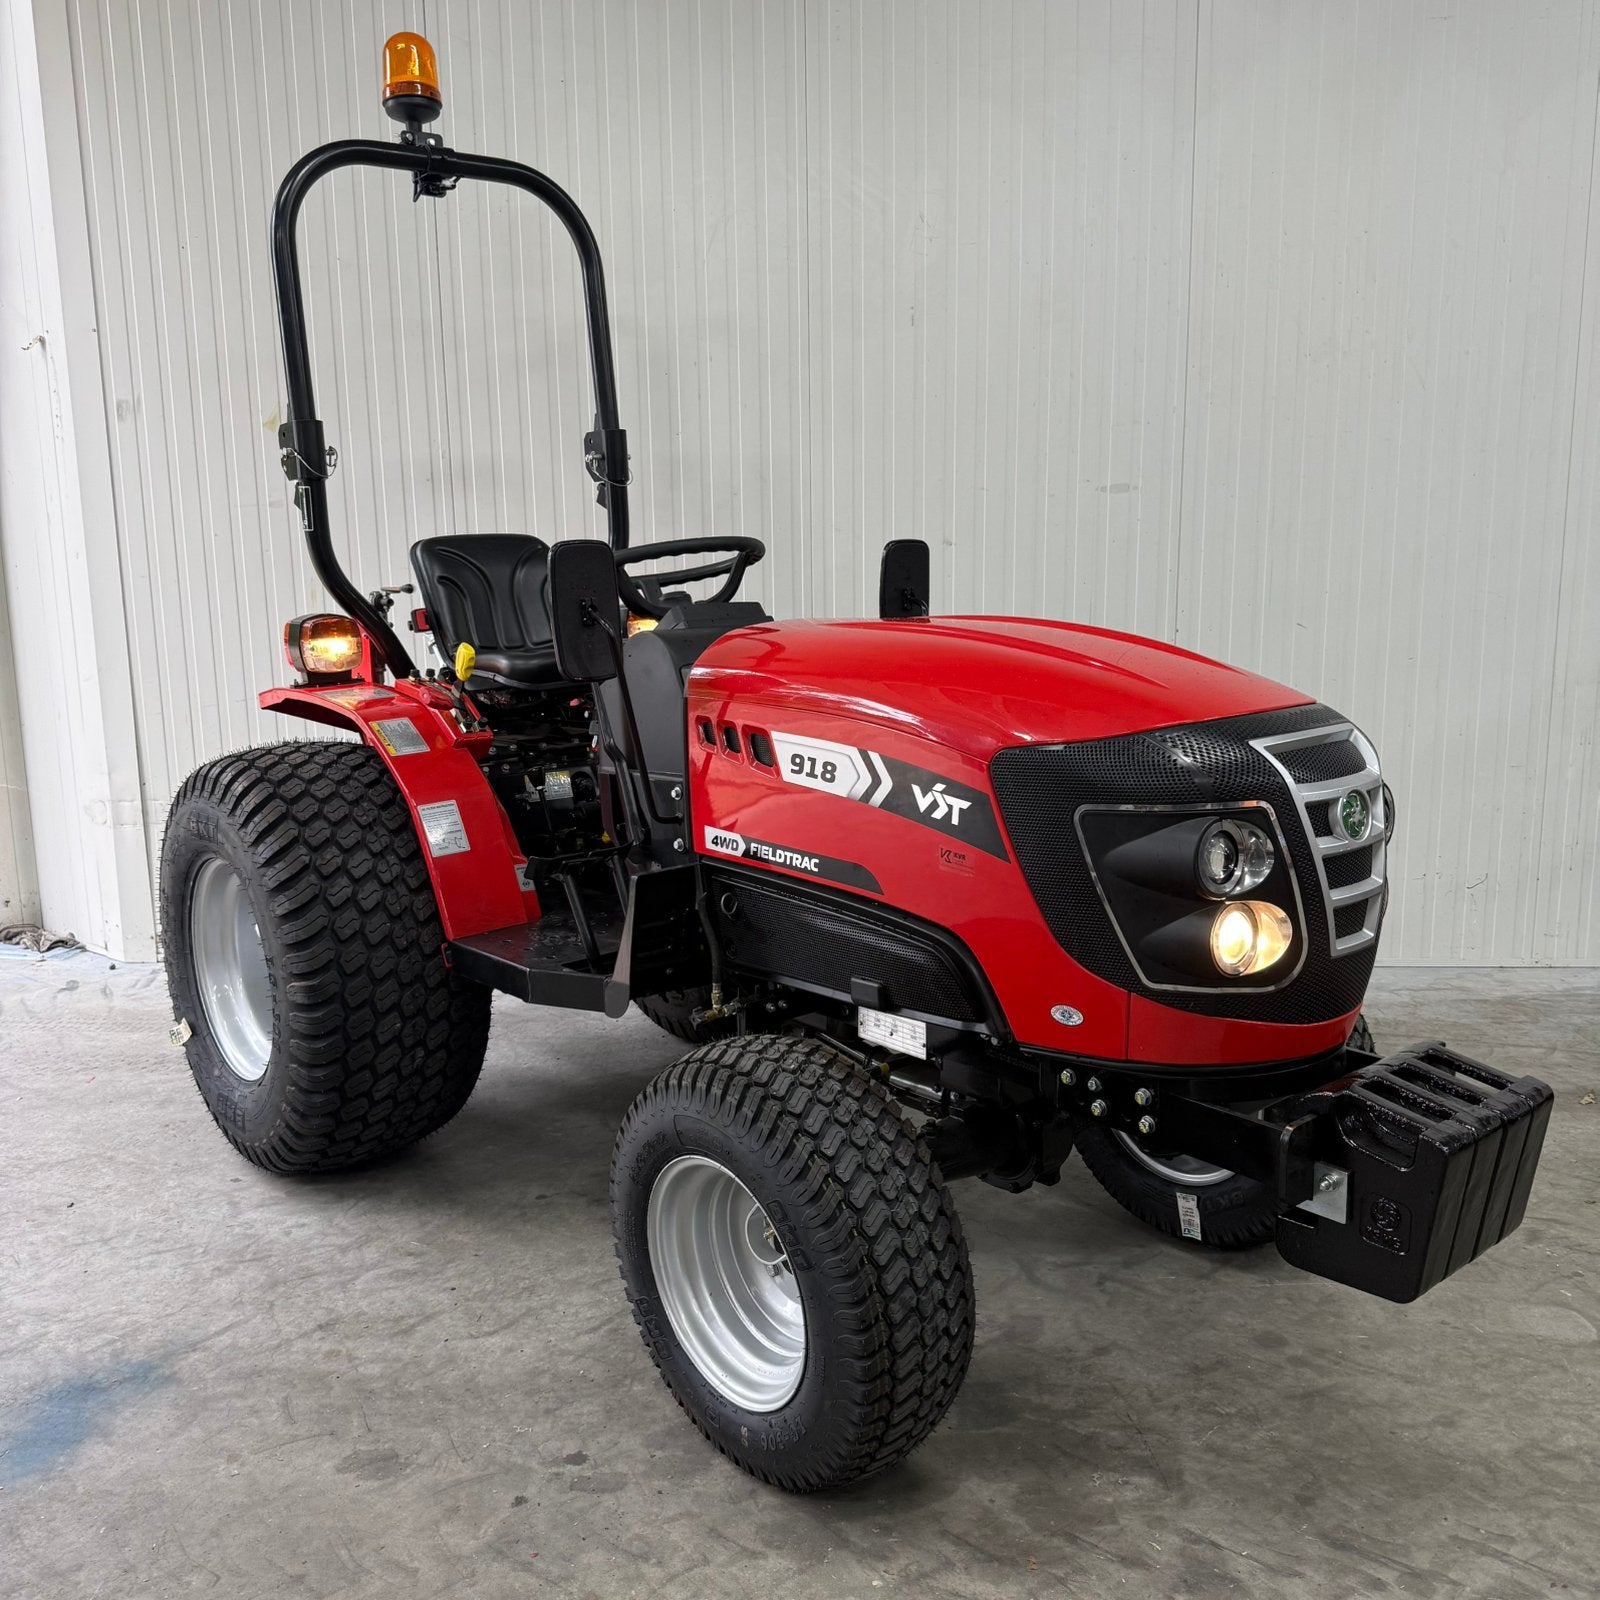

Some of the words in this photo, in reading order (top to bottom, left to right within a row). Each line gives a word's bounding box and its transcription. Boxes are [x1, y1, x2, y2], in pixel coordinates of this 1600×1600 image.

[790, 753, 837, 784] 918
[911, 782, 973, 826] VST
[711, 834, 740, 852] 4WD
[749, 842, 820, 872] FIELDTRAC
